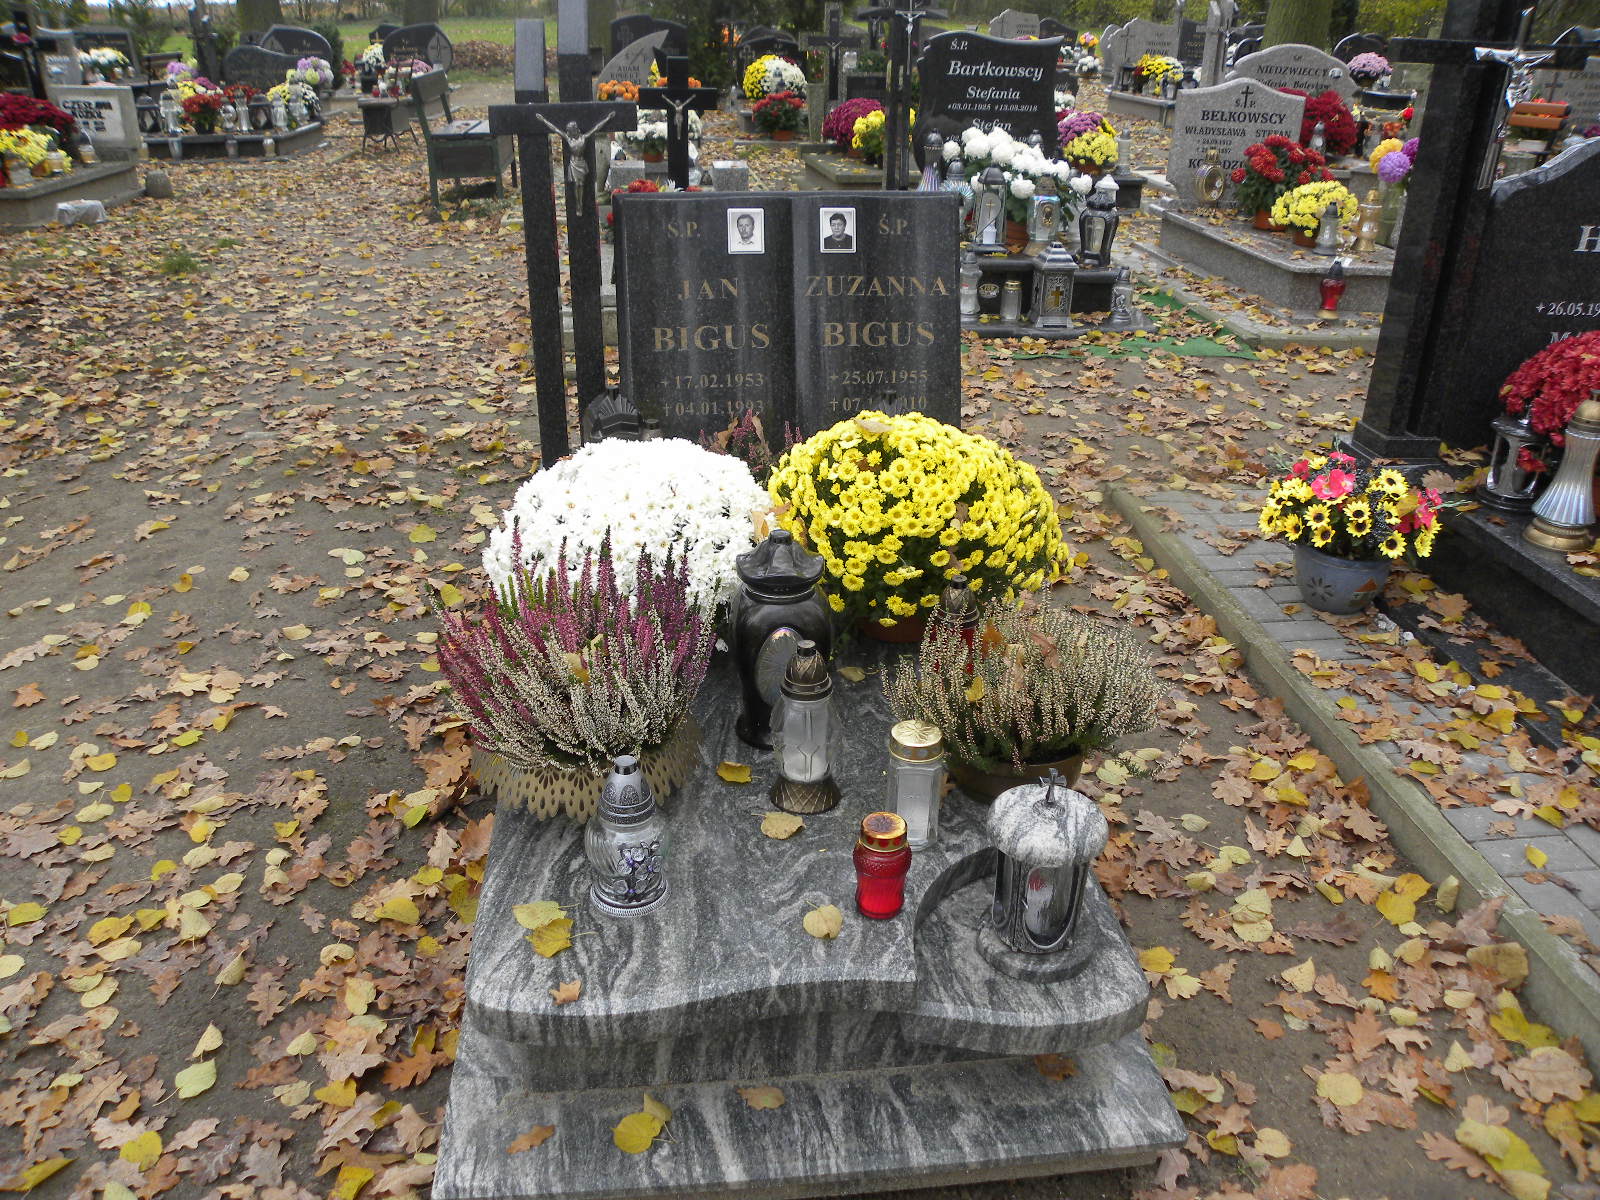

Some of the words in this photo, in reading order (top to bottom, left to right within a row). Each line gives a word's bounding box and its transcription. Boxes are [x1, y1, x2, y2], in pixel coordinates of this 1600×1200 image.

[946, 60, 1045, 82] Bartkowscy
[966, 85, 1021, 101] Stefania
[677, 277, 739, 301] JAN
[804, 274, 950, 298] ZUZANNA
[652, 322, 771, 352] BIGUS
[823, 320, 936, 348] BIGUS
[674, 373, 765, 390] 17.02.1953
[842, 369, 929, 386] 25.07.1955
